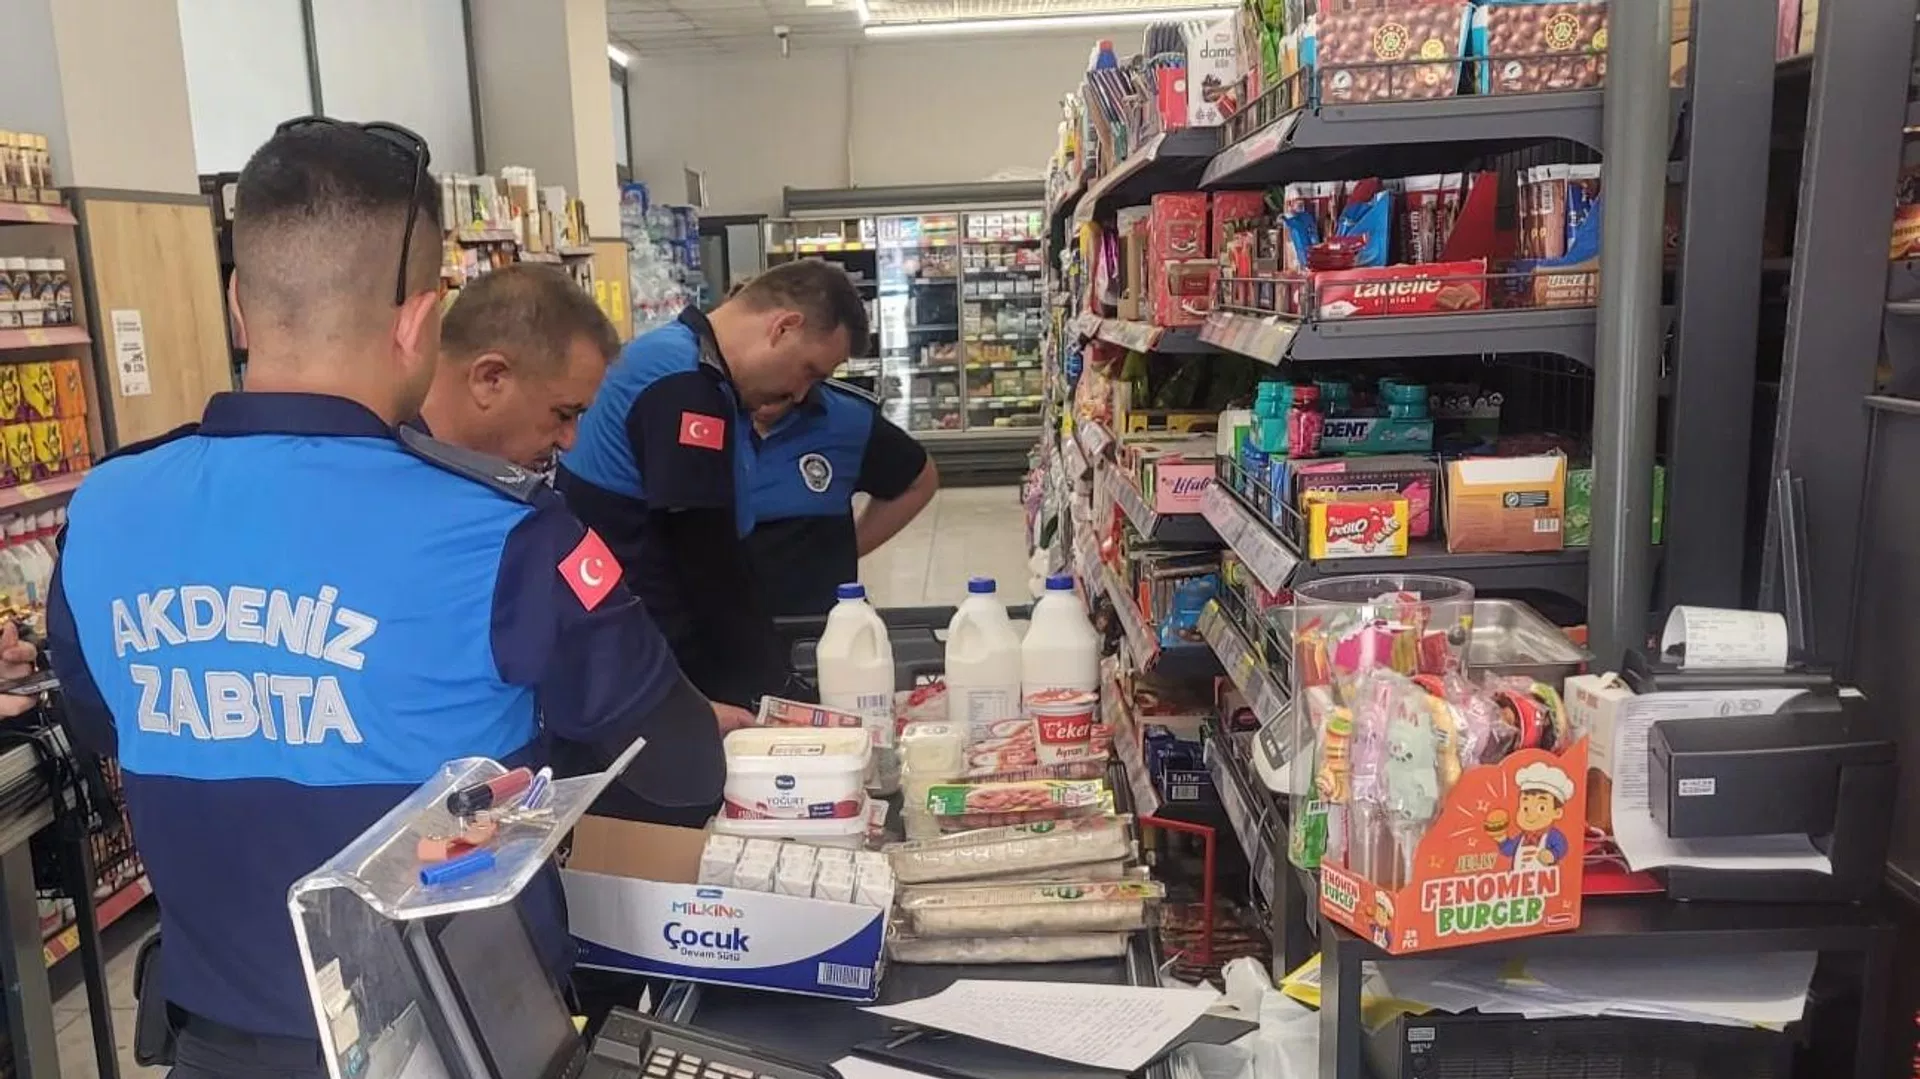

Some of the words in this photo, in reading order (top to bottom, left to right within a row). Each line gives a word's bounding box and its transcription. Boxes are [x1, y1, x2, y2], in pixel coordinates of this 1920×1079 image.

[112, 585, 378, 670] AKDENİZ
[130, 664, 363, 745] ZABITA
[1422, 869, 1559, 911] FENOMEN
[663, 921, 750, 952] Çocuk
[1437, 897, 1545, 936] BURGER
[681, 947, 714, 958] Devam
